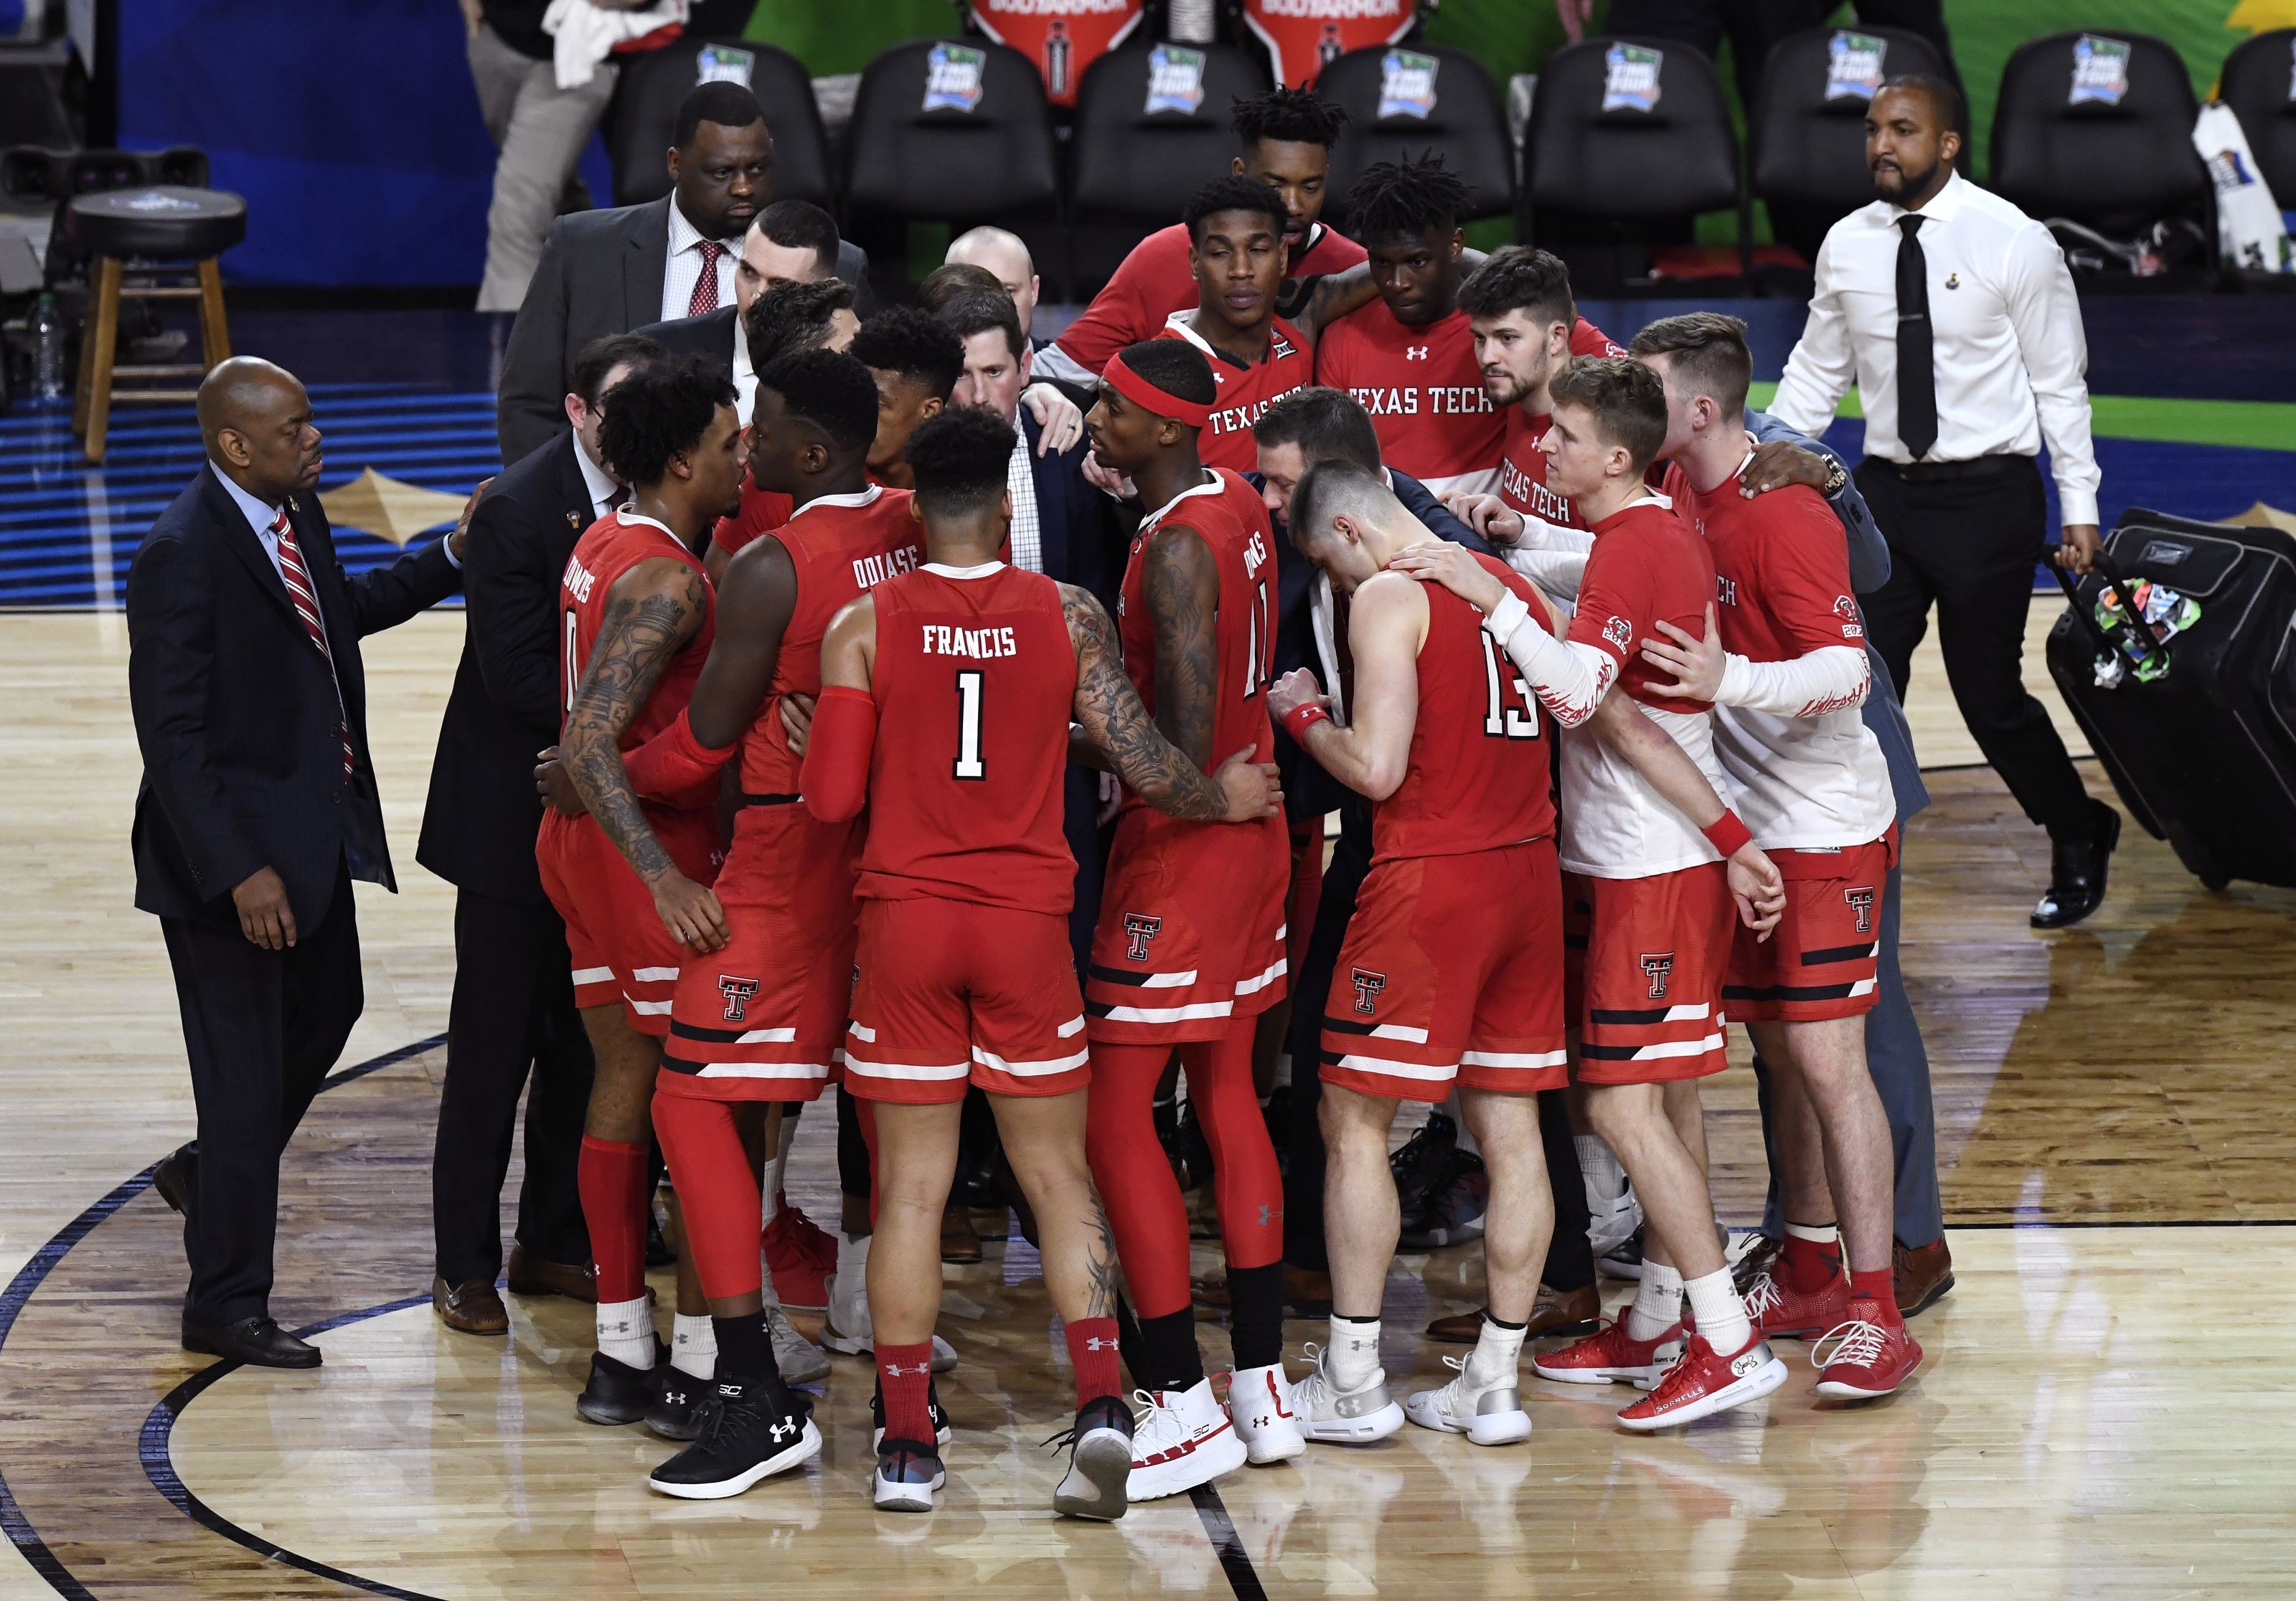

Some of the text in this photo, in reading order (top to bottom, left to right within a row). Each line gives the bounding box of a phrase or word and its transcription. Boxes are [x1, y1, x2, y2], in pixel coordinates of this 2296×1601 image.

[1428, 387, 1494, 414] TECH
[1531, 481, 1570, 523] TECH
[922, 625, 1017, 659] FRANCIS
[1244, 580, 1269, 698] 11
[954, 671, 984, 779] 1
[1656, 1386, 1704, 1412] SORRELLS
